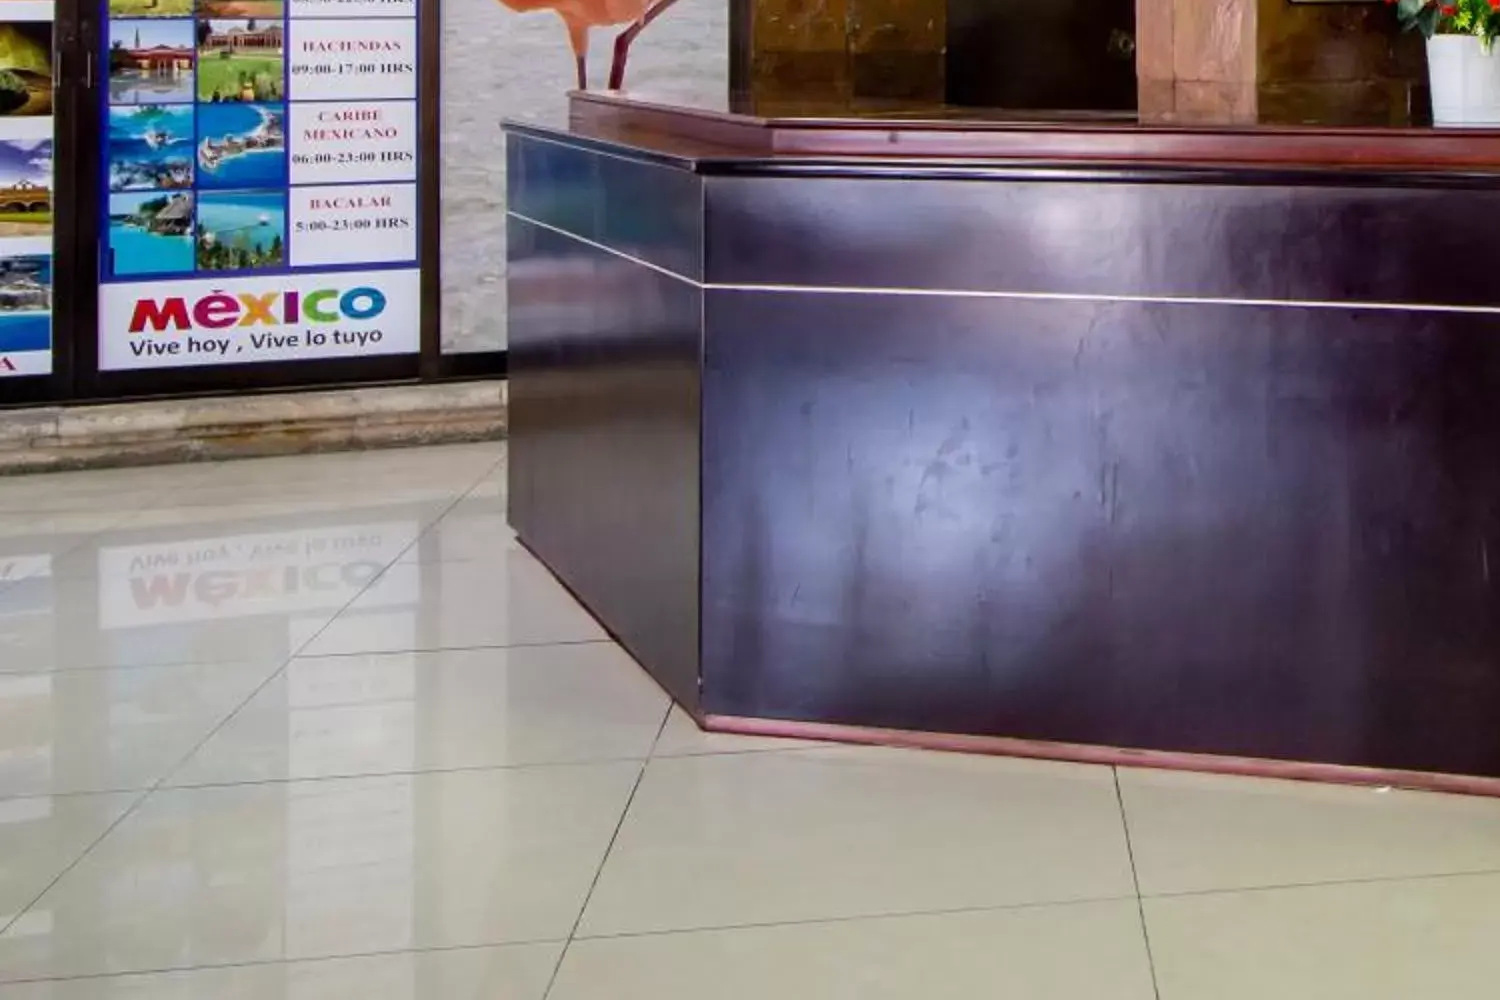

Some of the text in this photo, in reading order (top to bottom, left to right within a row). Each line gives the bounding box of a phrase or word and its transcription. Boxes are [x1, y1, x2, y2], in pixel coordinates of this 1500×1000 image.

[303, 39, 402, 52] HACIENDAS
[380, 62, 413, 74] HRS
[318, 108, 382, 122] CARIBE
[304, 126, 399, 140] MEXICANO
[380, 149, 413, 162] HRS
[308, 195, 392, 210] BACALAR
[375, 216, 410, 230] HRS
[129, 337, 181, 357] Vive
[250, 331, 300, 350] Vive
[305, 328, 327, 347] lo
[333, 327, 384, 349] tuyo
